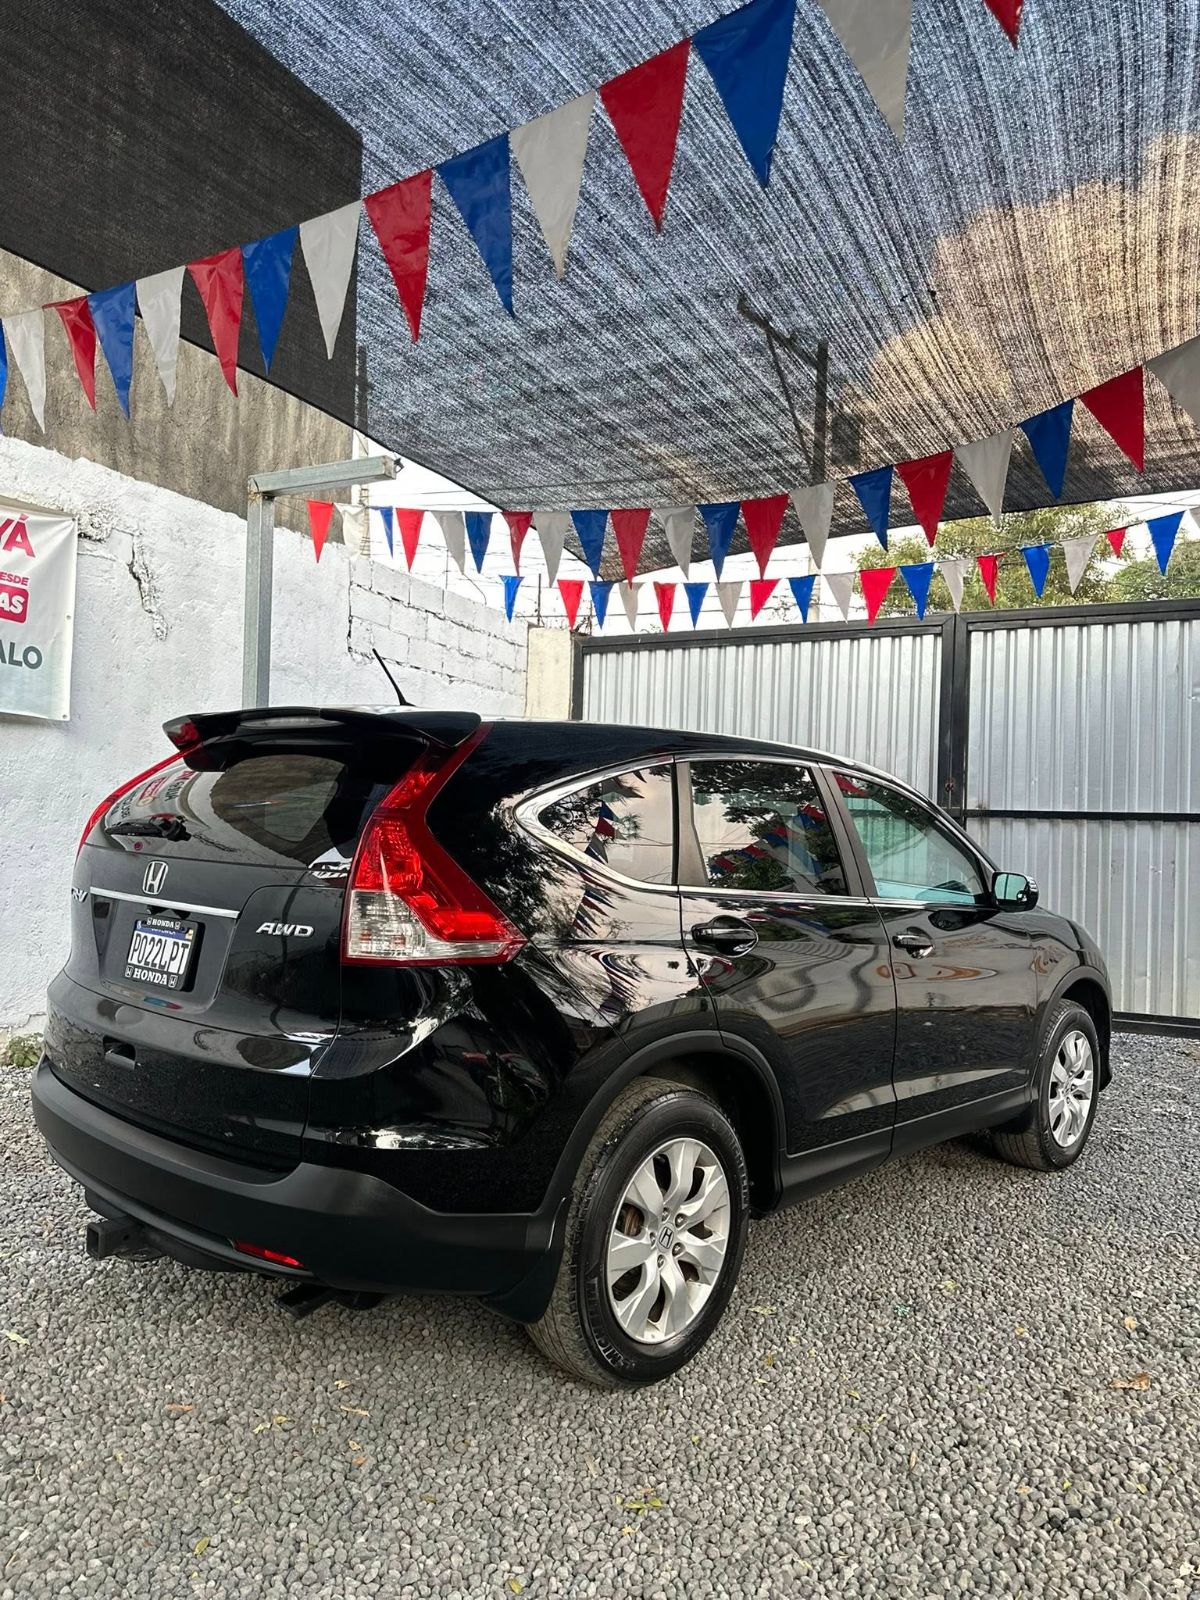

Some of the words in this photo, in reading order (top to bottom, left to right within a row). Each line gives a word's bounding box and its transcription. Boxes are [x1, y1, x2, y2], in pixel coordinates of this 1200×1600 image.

[152, 918, 174, 928] HONDA
[256, 922, 315, 937] AWD
[133, 968, 168, 985] HONDA
